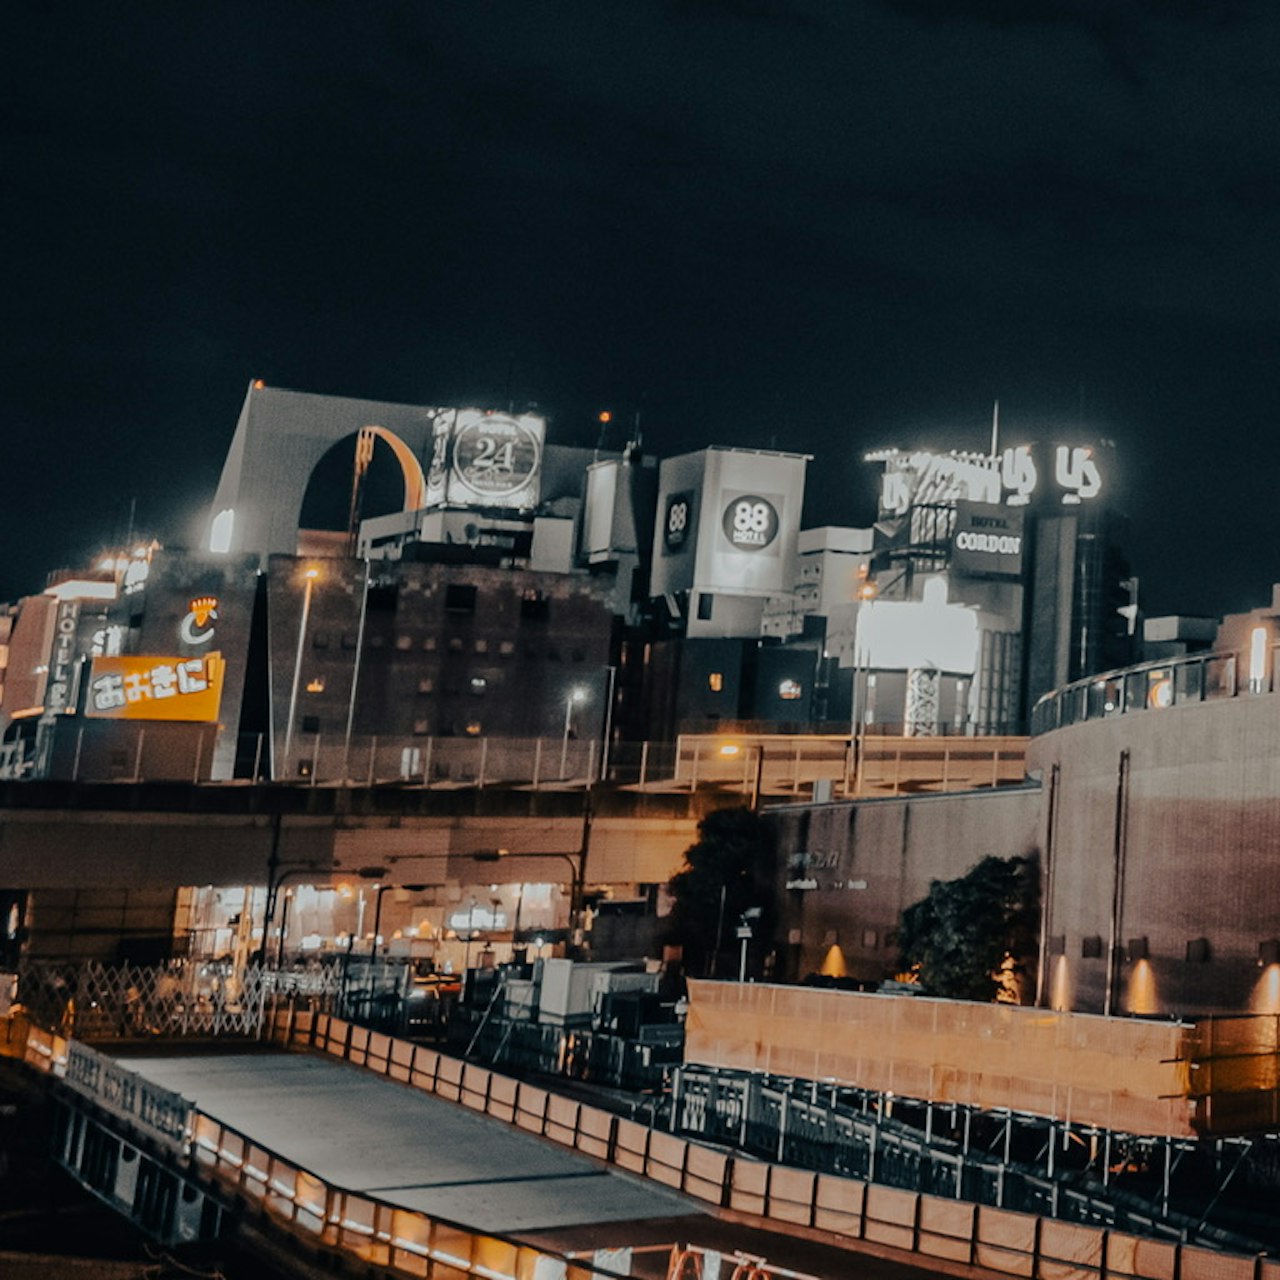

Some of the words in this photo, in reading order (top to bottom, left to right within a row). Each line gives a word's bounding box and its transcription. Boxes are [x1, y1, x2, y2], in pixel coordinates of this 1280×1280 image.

[473, 437, 513, 468] 24
[669, 502, 687, 532] 88
[734, 502, 769, 532] 88
[956, 531, 1021, 554] CORDON
